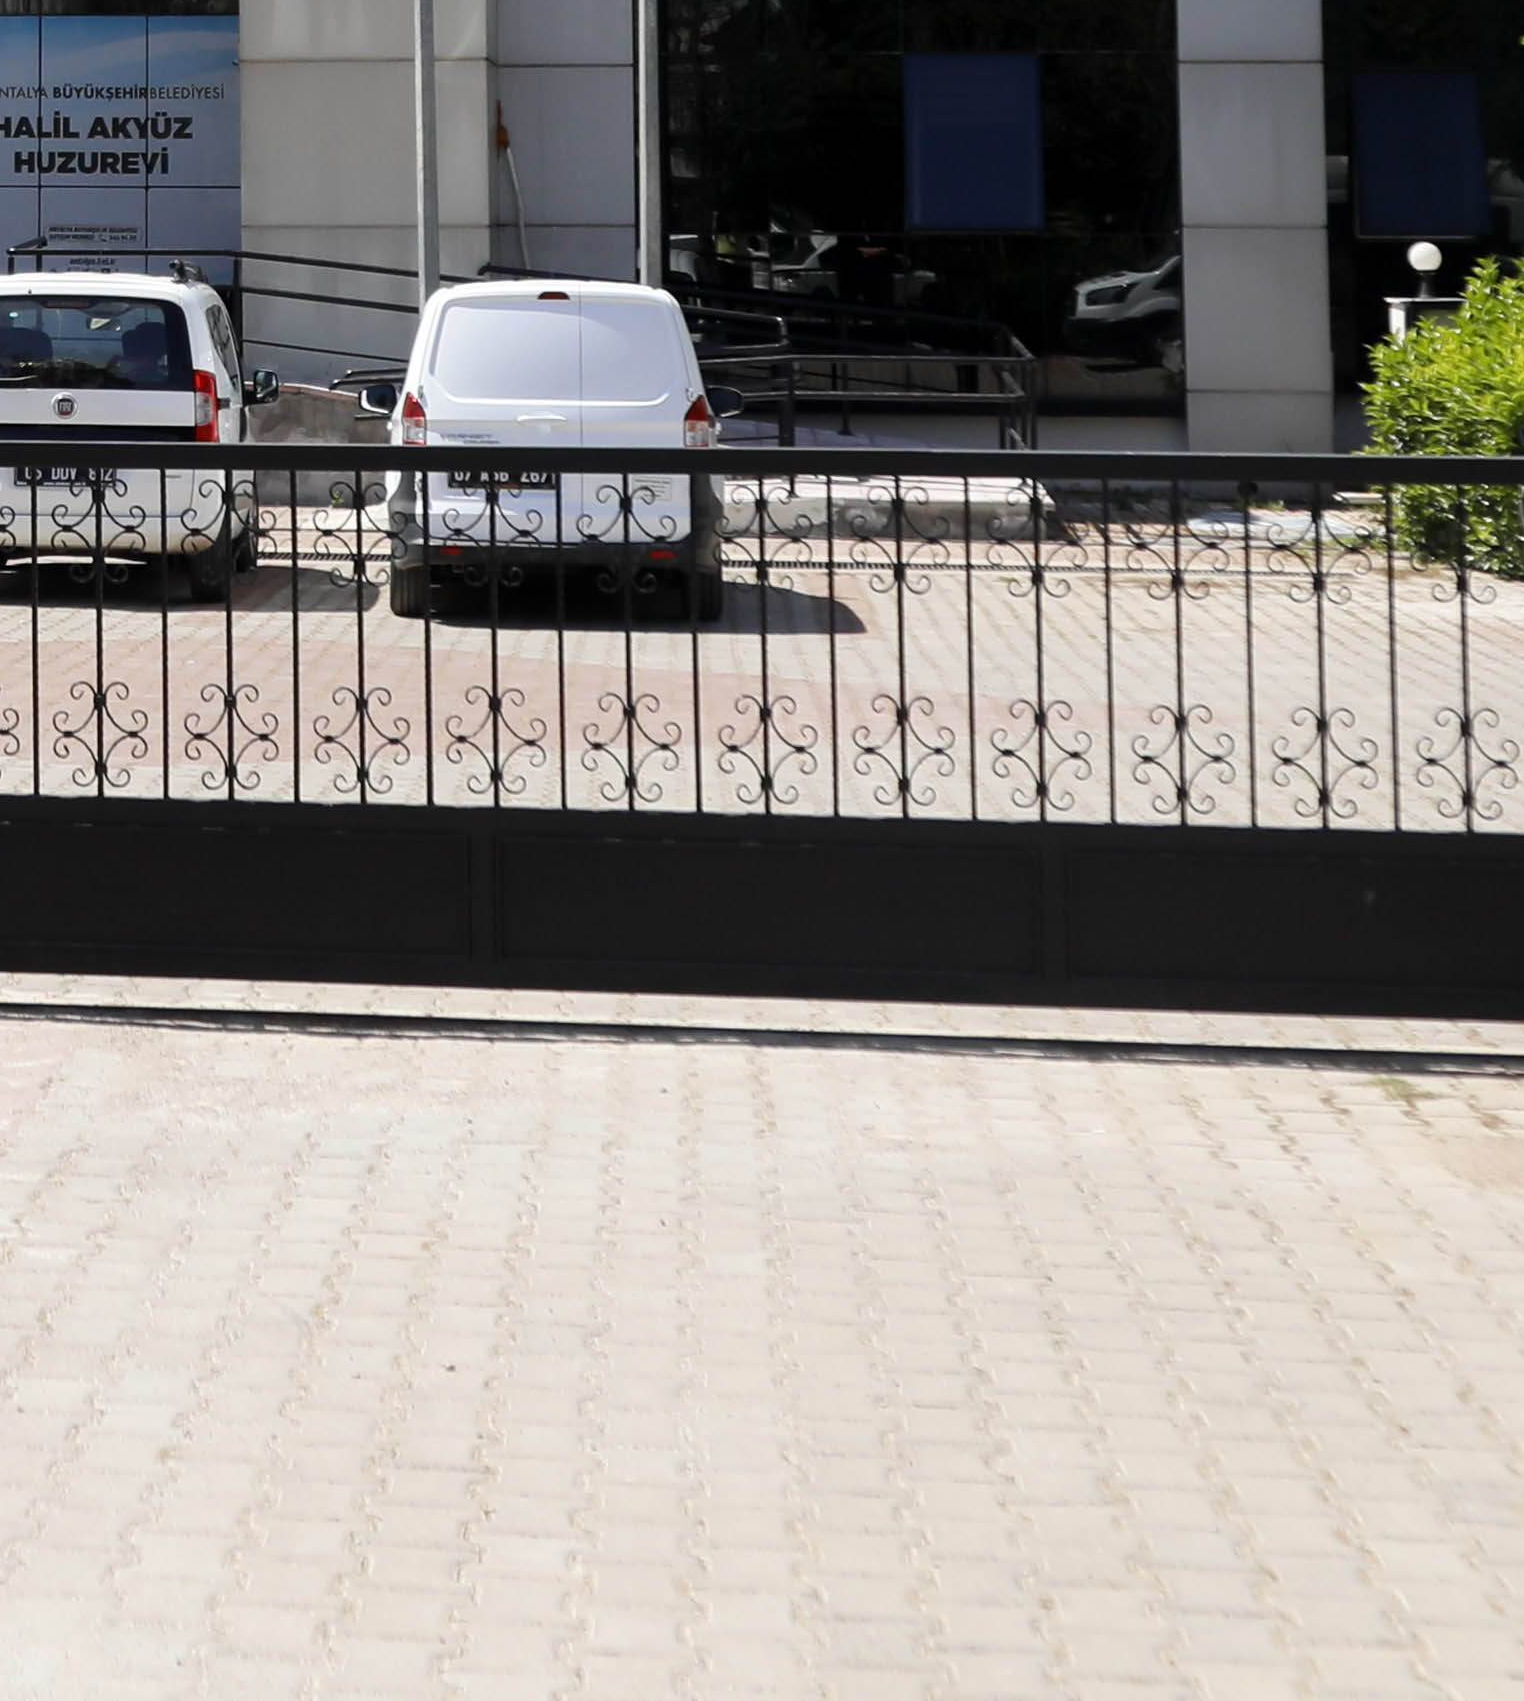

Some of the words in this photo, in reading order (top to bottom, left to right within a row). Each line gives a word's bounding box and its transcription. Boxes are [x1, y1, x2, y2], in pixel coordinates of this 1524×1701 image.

[53, 84, 148, 102] BÜYÜKŞEHİR
[149, 83, 224, 100] BELEDİYESİ
[87, 112, 193, 139] AKYÜZ
[14, 147, 169, 174] HUZUREVİ
